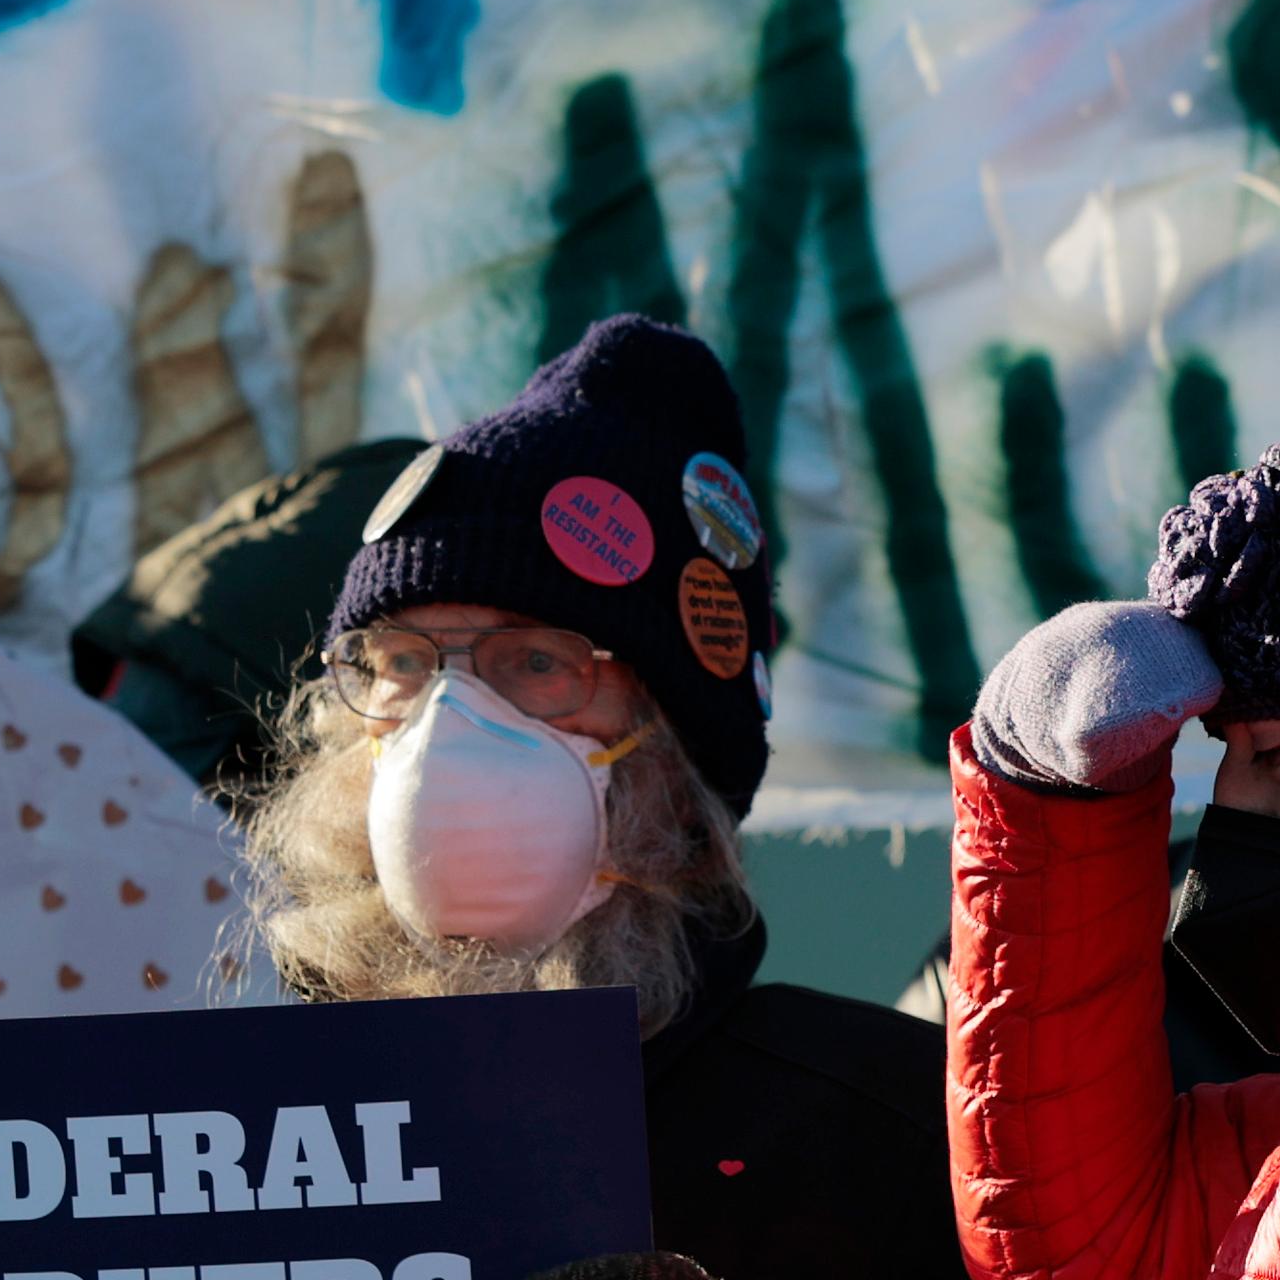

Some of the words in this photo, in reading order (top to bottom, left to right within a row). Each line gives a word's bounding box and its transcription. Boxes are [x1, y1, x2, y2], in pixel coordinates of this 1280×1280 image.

[543, 503, 640, 582] RESISTANCE
[568, 493, 600, 520] AM
[605, 515, 637, 549] THE
